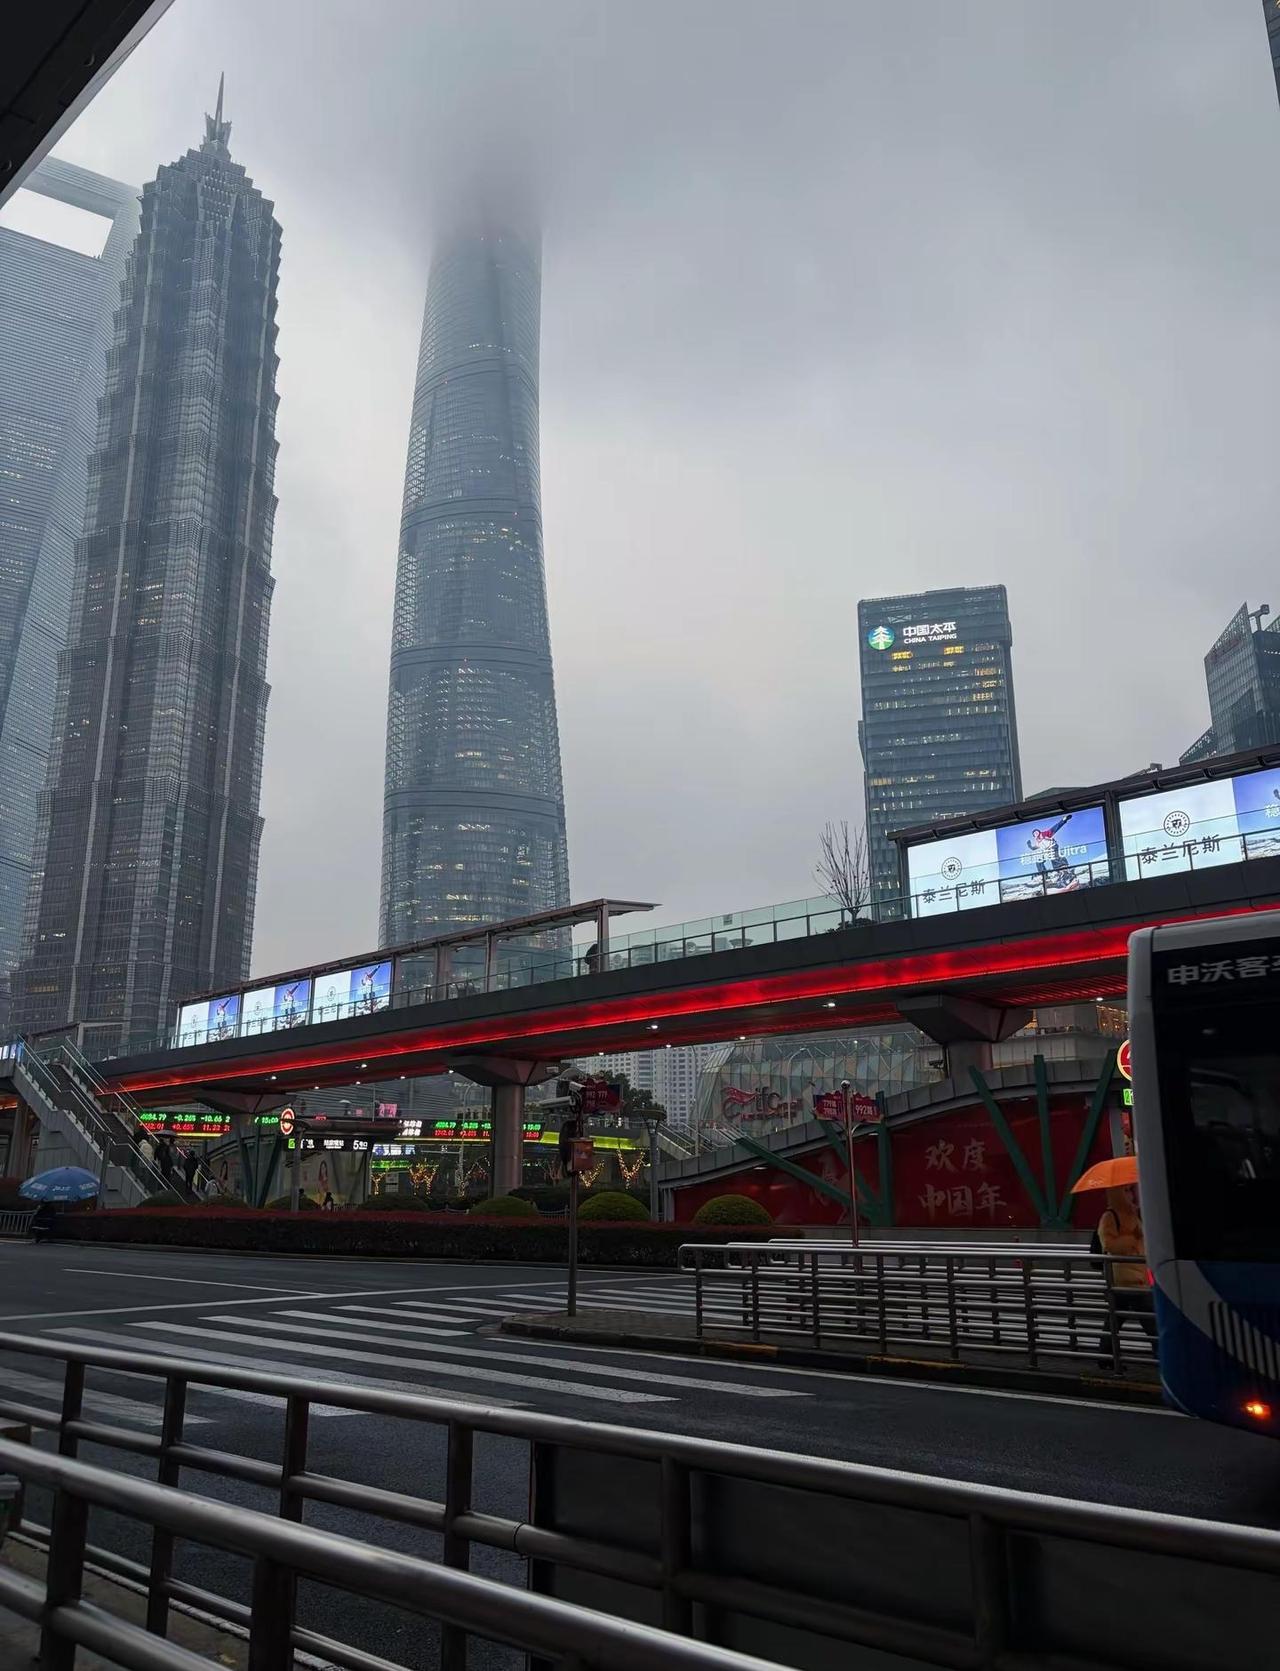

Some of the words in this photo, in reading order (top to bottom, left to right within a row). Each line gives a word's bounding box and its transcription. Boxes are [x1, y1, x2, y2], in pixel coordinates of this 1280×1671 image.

[902, 621, 957, 637] 中国太平
[904, 637, 926, 645] CHINA
[928, 633, 957, 643] TAIPING
[1058, 845, 1087, 858] Ultra
[1140, 833, 1221, 865] 泰兰尼斯
[922, 878, 986, 905] 泰兰尼斯
[1167, 955, 1280, 985] 申沃客
[923, 1138, 988, 1174] 欢度
[918, 1182, 1008, 1221] 中国年
